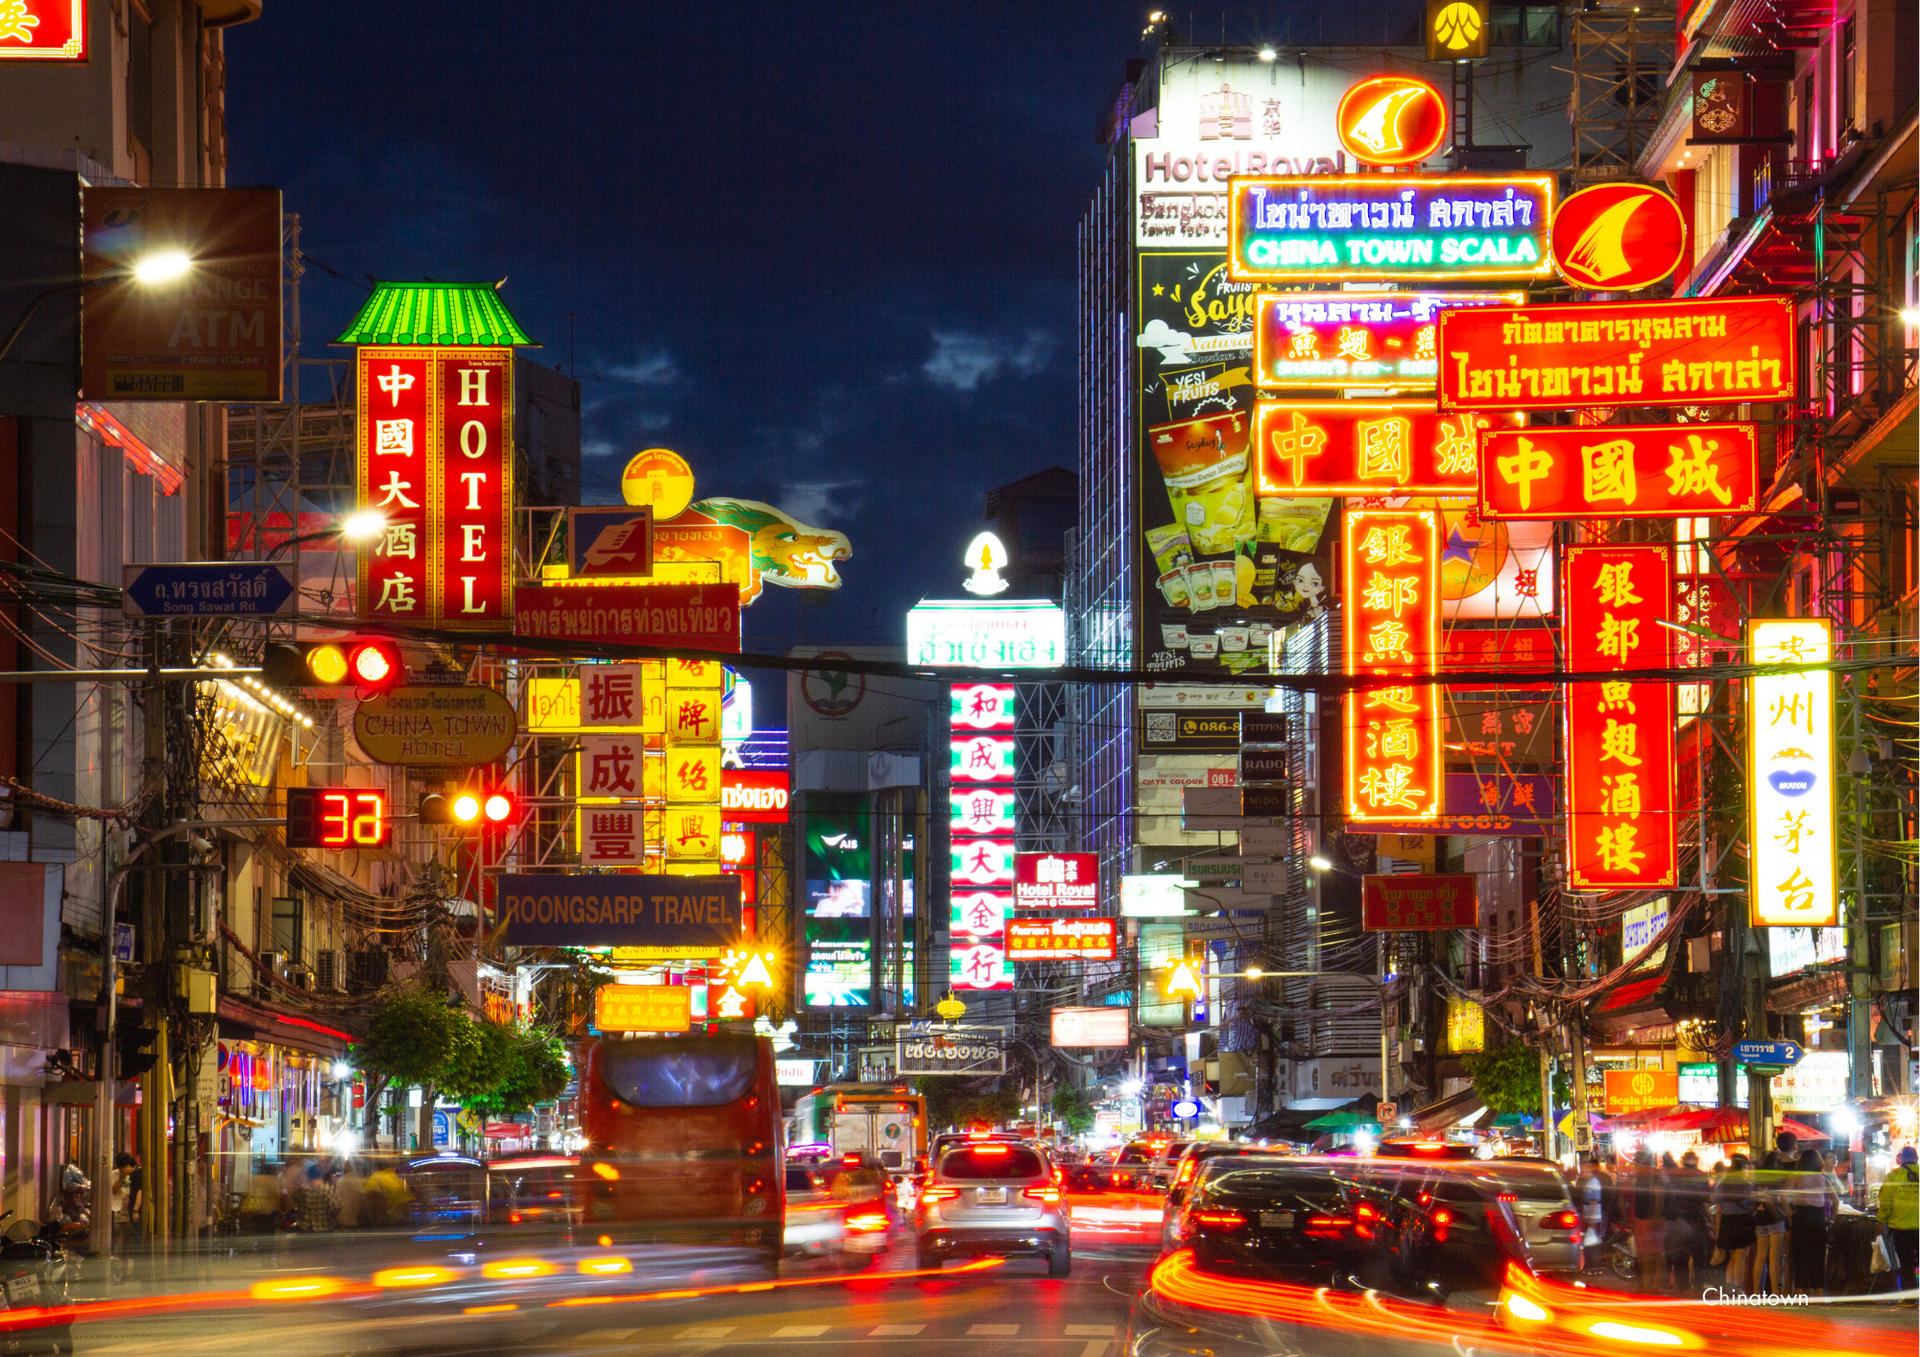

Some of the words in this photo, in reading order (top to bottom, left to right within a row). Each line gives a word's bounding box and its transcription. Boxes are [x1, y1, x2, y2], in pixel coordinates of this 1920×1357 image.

[1146, 151, 1240, 183] Hotel
[1139, 193, 1227, 226] Bangkok
[1249, 240, 1338, 265] CHINA
[1346, 240, 1434, 264] TOWN
[1440, 237, 1538, 263] SCALA
[168, 311, 266, 348] ATM
[1175, 370, 1207, 391] YES!
[1173, 382, 1221, 407] FRUITS
[1497, 434, 1733, 511] 中國城
[374, 364, 421, 613] 中國大酒店
[457, 368, 491, 614] HOTEL
[163, 602, 193, 615] Song
[200, 602, 235, 612] Sawat
[1359, 525, 1425, 811] 銀都魚翅酒樓
[364, 715, 435, 736] CHINA
[443, 715, 507, 736] TOWN
[1593, 562, 1646, 875] 銀都魚翅酒樓
[401, 740, 469, 757] HOTEL
[1244, 760, 1284, 769] RADO
[839, 840, 858, 849] AIS
[968, 691, 997, 982] 和成興大金行
[1017, 882, 1053, 896] Hotel
[1056, 882, 1096, 897] Royal
[505, 894, 644, 925] ROONGSARP
[651, 894, 734, 925] TRAVEL
[1785, 1046, 1794, 1059] 2
[1609, 1096, 1640, 1105] Scala
[1643, 1096, 1678, 1105] Hostel
[888, 1124, 898, 1138] 7
